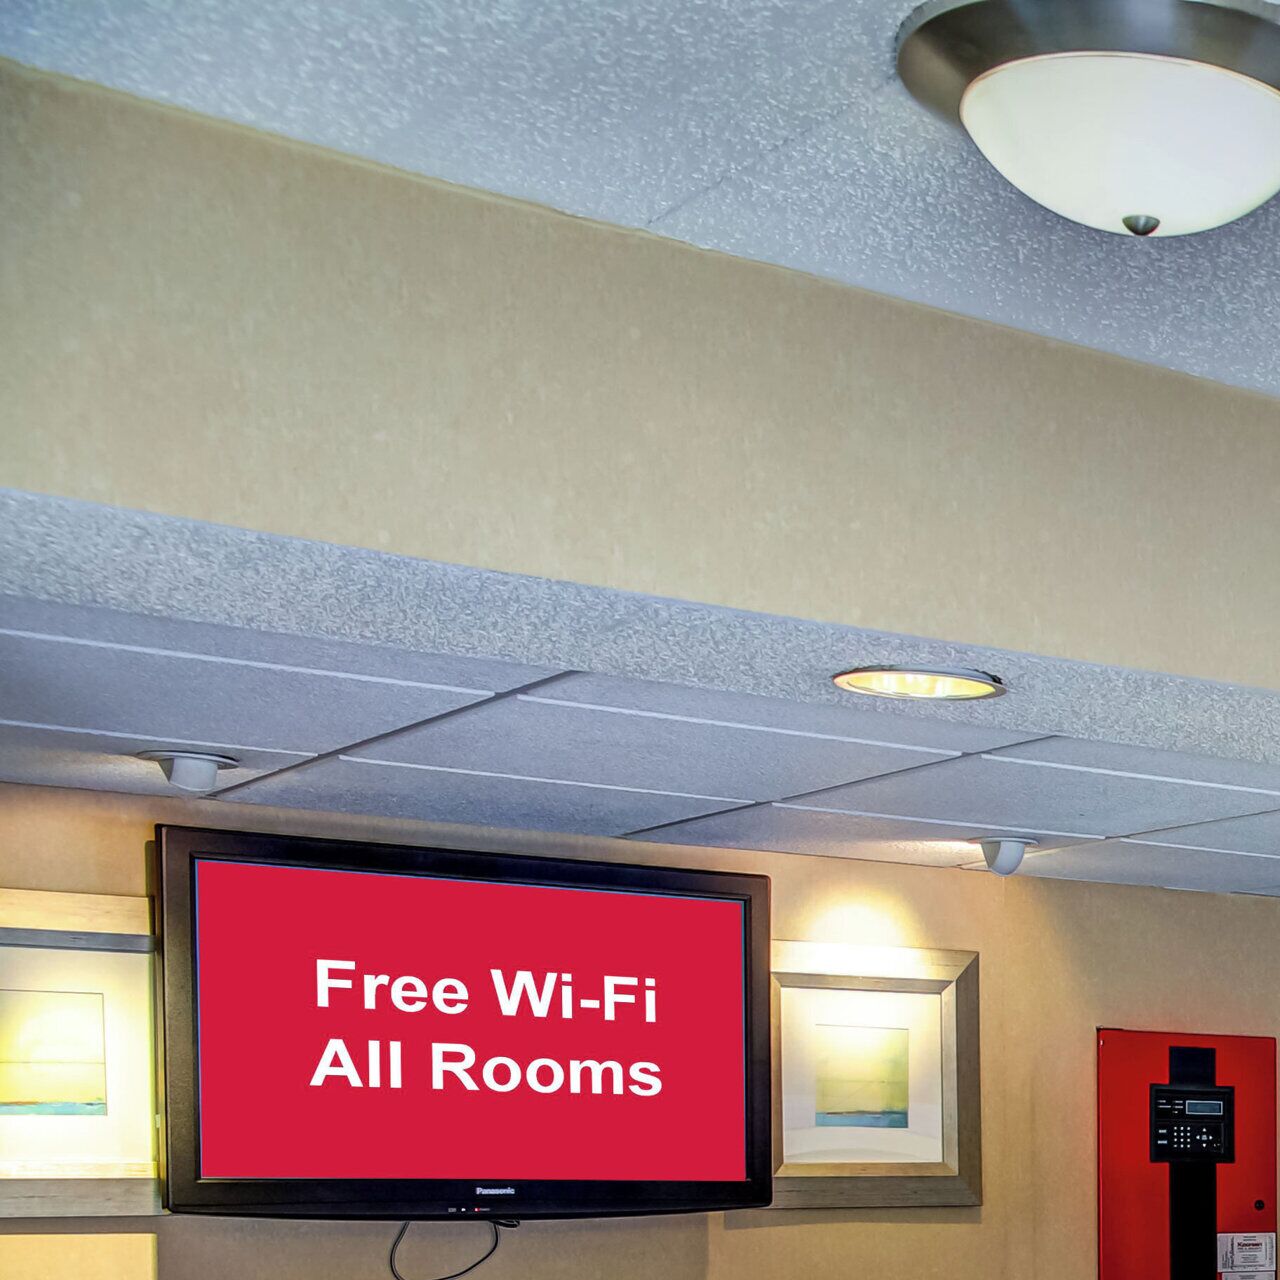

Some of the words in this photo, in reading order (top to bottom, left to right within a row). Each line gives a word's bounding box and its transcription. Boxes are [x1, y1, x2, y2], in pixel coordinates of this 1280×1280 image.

[315, 957, 471, 1016] Free
[490, 968, 658, 1024] Wi-Fi
[309, 1037, 402, 1090] All
[431, 1042, 663, 1097] Rooms
[476, 1187, 515, 1195] Panasonic
